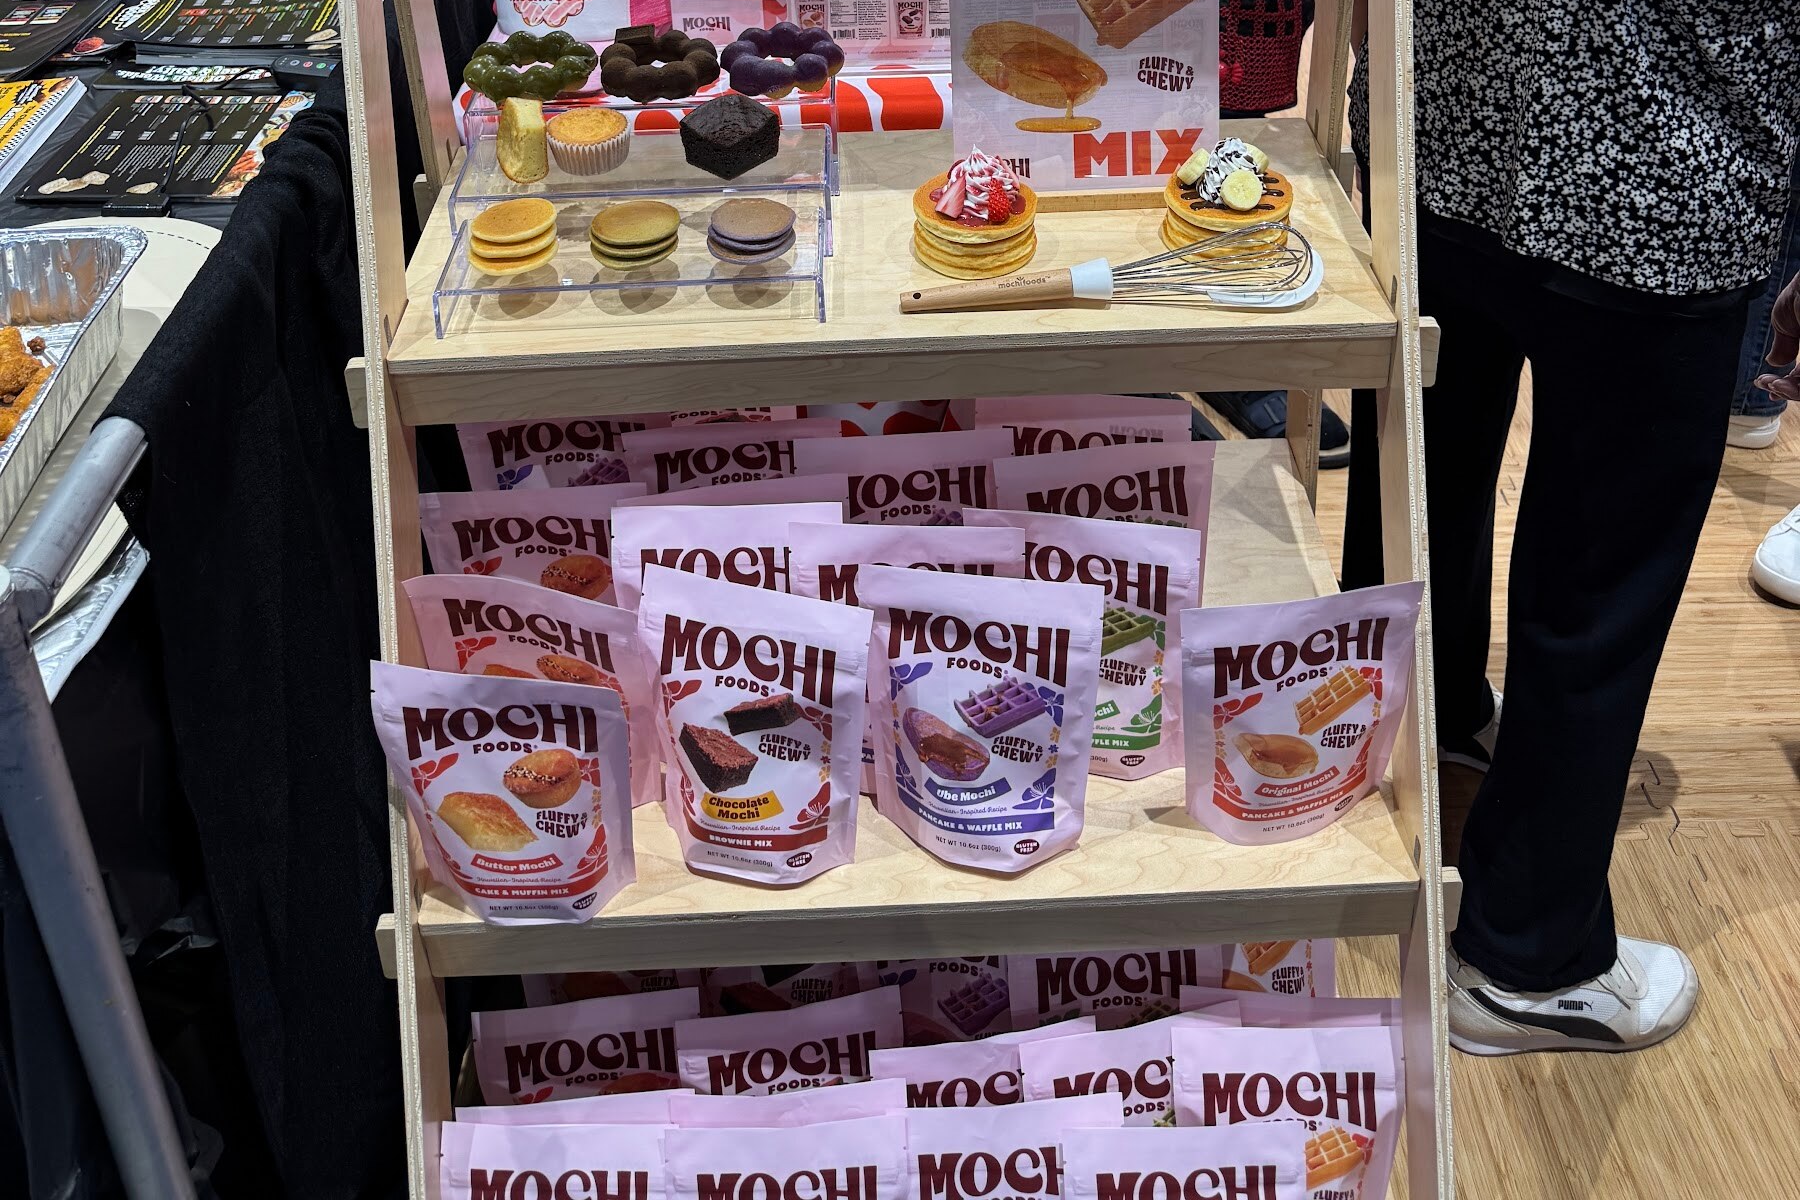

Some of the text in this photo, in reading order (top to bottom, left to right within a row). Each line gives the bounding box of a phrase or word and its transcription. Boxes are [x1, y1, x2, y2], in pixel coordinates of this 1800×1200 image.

[800, 4, 825, 12] MOCHI
[898, 2, 923, 10] MOCHI
[682, 17, 731, 32] MOCHI
[1139, 57, 1194, 76] FLUFFY &
[1137, 69, 1194, 92] CHEWY
[1073, 129, 1203, 178] MIX
[1027, 466, 1188, 519] MOCHI
[443, 598, 616, 674] MOCHI
[888, 607, 1070, 687] MOCHI
[660, 614, 836, 708] MOCHI
[1213, 617, 1390, 698] MOCHI
[1276, 667, 1328, 692] FOODS
[402, 704, 599, 760] MOCHI
[1323, 723, 1359, 737] FLUFFY
[758, 743, 811, 762] CHEWY
[760, 734, 811, 751] FLUFFY &
[993, 736, 1043, 753] FLUFFY &
[991, 745, 1043, 762] CHEWY
[1262, 770, 1335, 796] Original Mochi
[709, 796, 770, 809] Chocolate
[937, 786, 996, 801] Ube Mochi
[1296, 799, 1328, 812] WAFFLE
[1330, 791, 1343, 801] MIX
[537, 810, 579, 824] FLUFFY
[718, 808, 760, 820] Mochi
[919, 807, 955, 829] PANCAKE
[1004, 822, 1023, 830] MIX
[536, 818, 587, 838] CHEWY
[710, 835, 752, 846] BROWNIE
[477, 858, 556, 871] Butter Mochi
[1036, 948, 1199, 1014] MOCHI
[1557, 1000, 1584, 1011] PUMA
[505, 1028, 678, 1093] MOCHI
[708, 1030, 876, 1096] MOCHI
[1203, 1072, 1376, 1132] MOCHI
